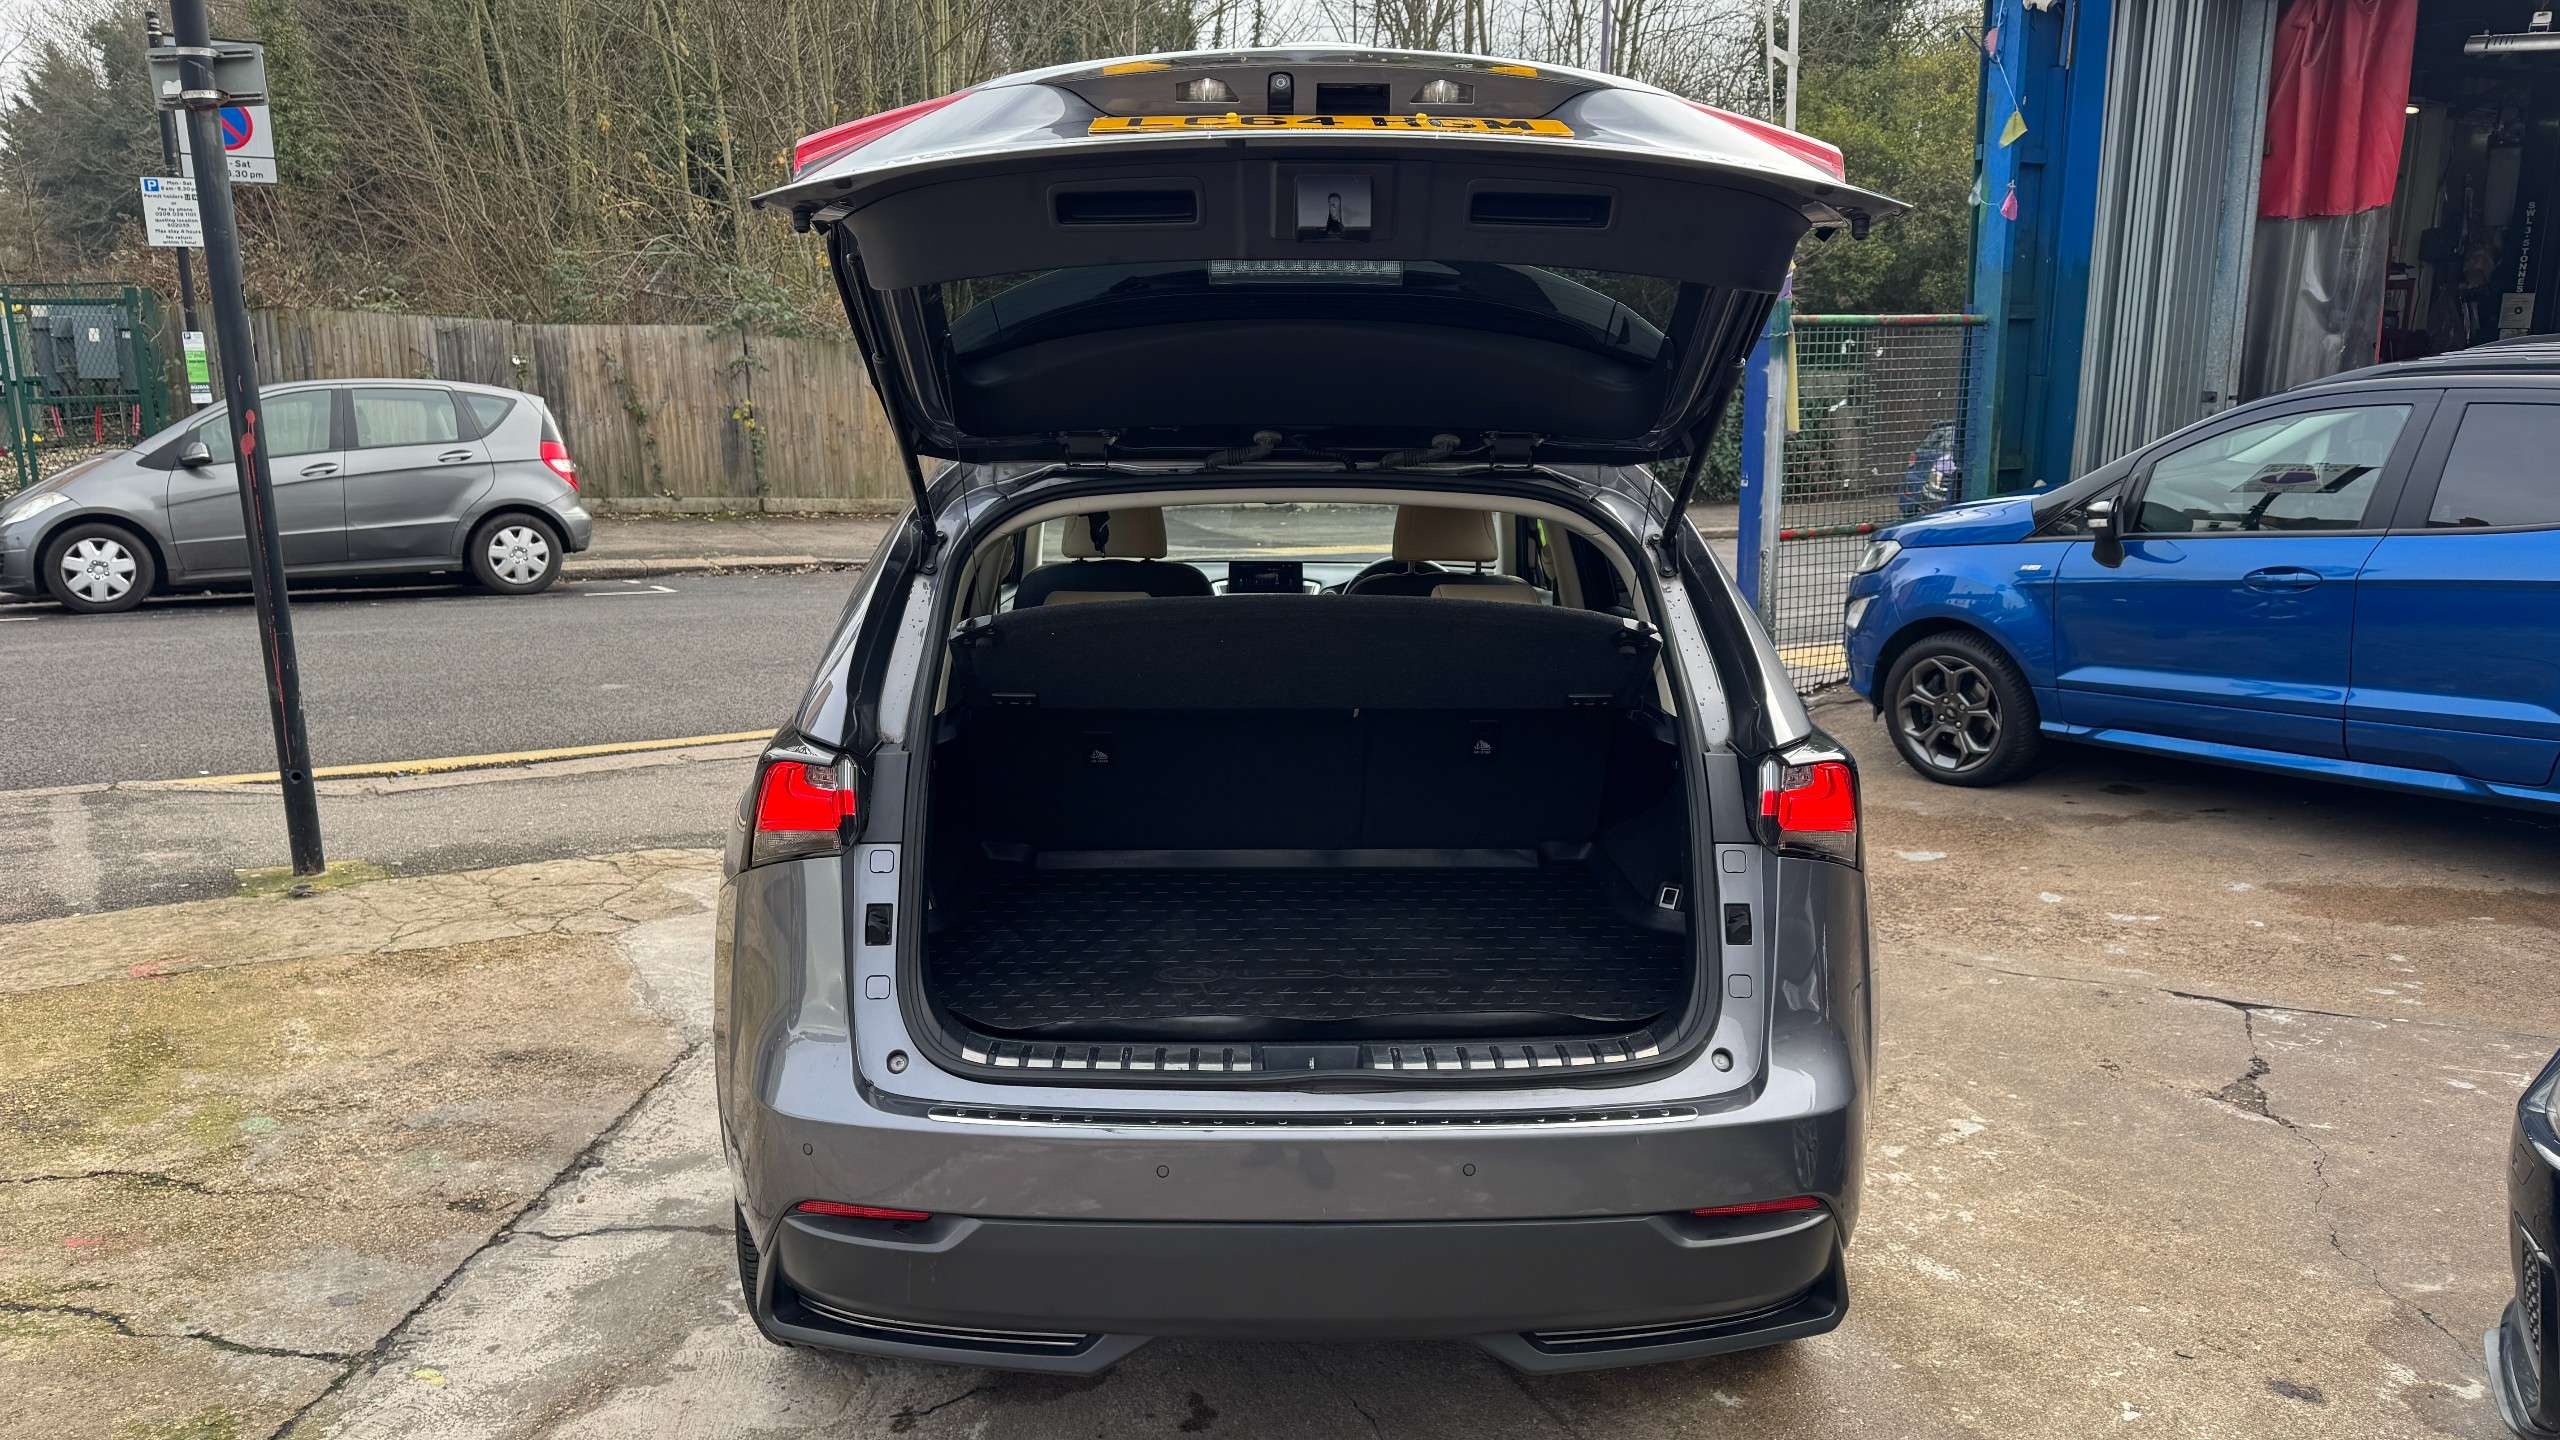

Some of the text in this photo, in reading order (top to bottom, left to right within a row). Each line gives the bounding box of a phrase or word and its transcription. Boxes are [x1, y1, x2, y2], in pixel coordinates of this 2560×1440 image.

[234, 160, 251, 168] Sat
[146, 180, 157, 191] P
[2516, 248, 2530, 292] TONNES
